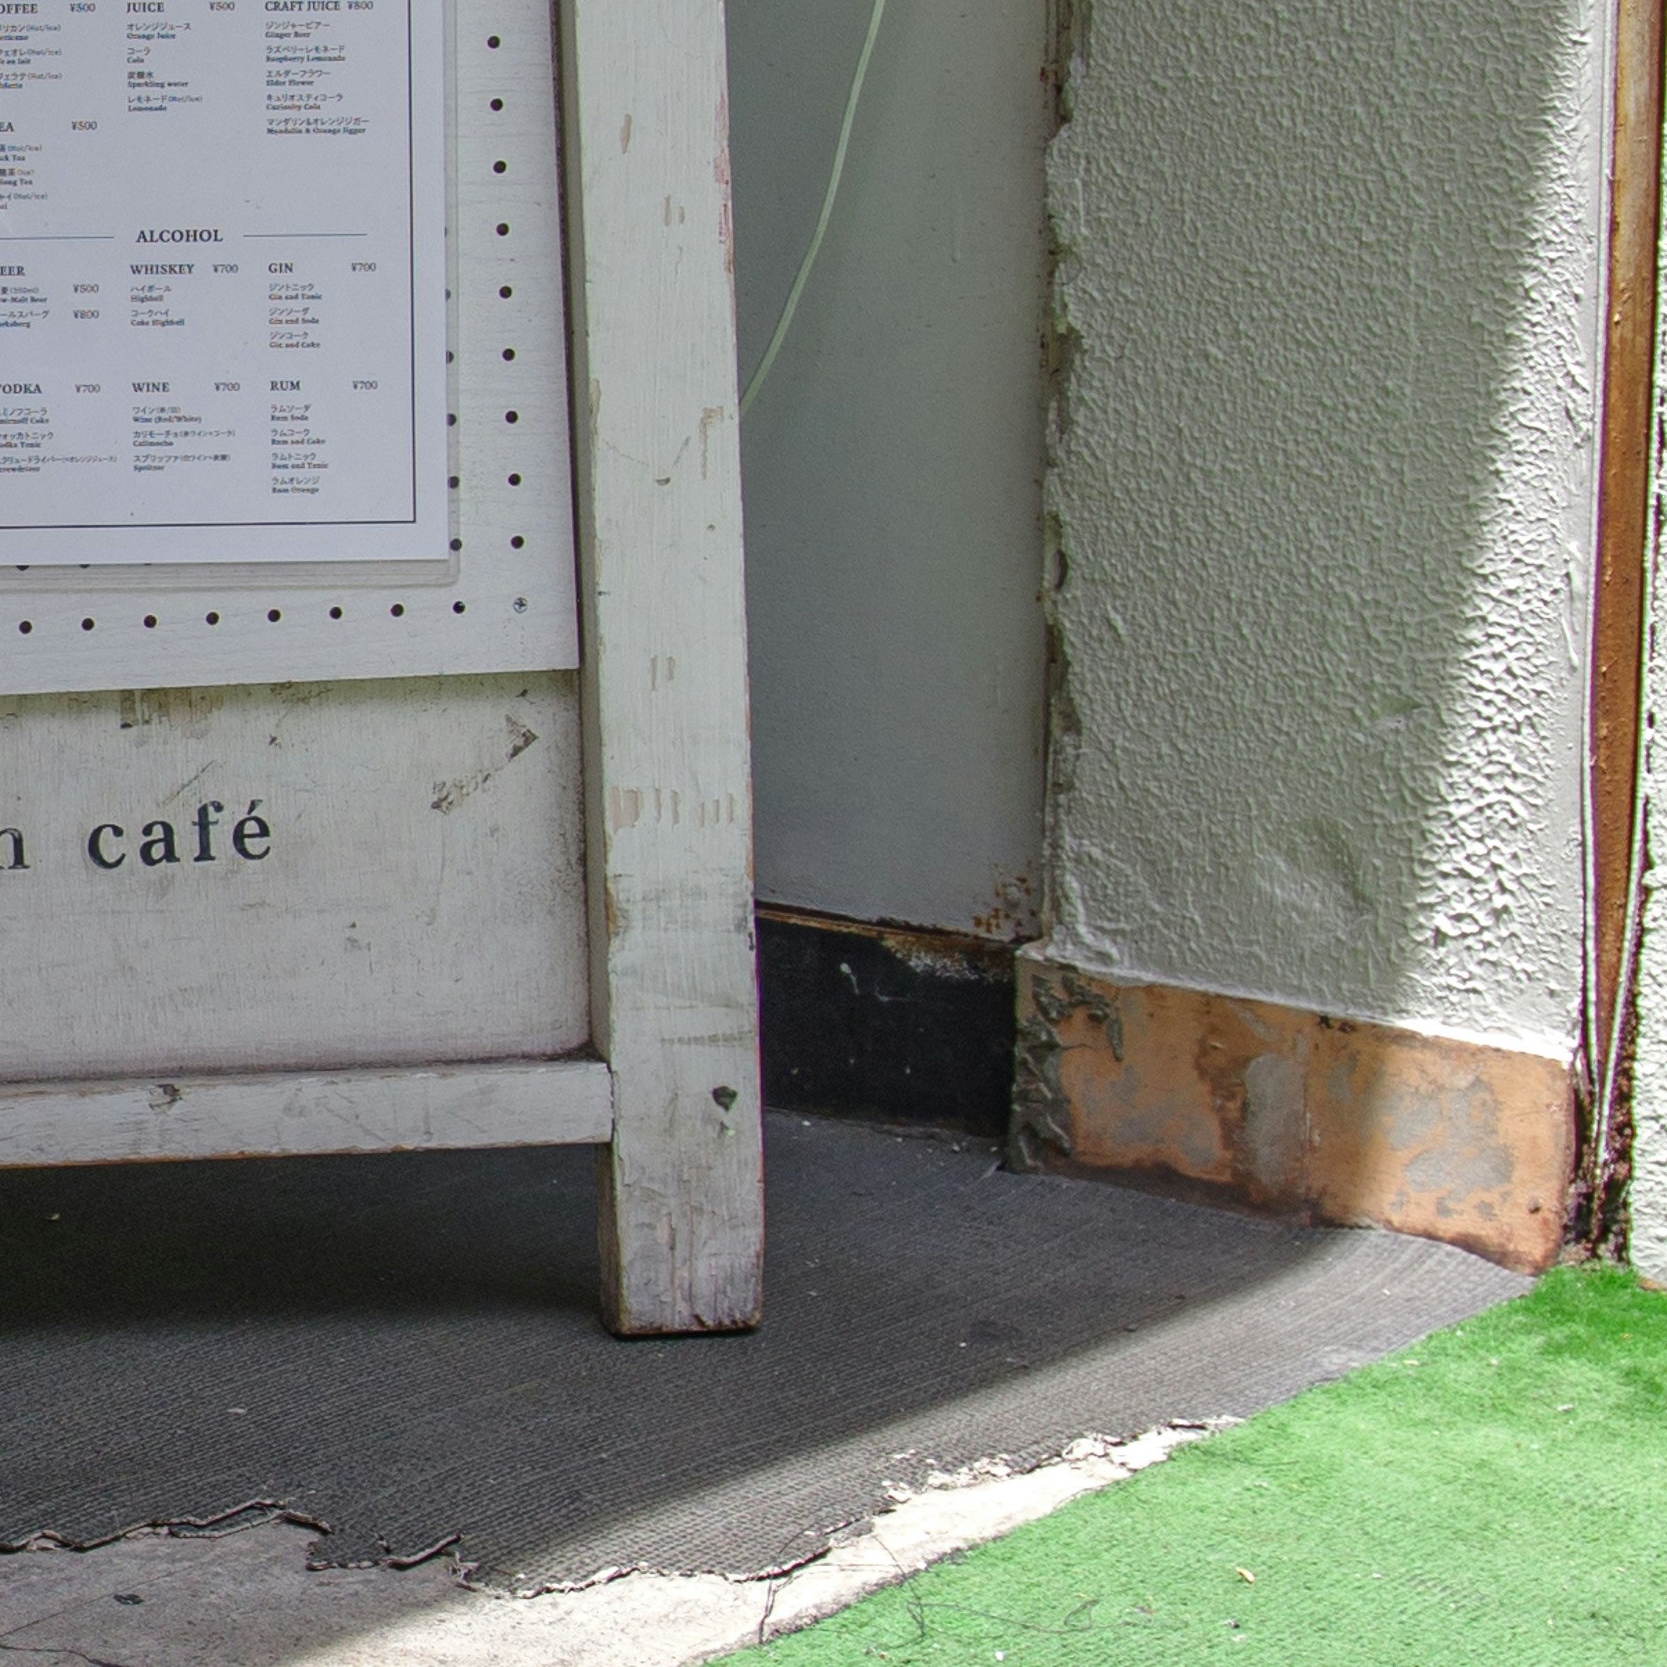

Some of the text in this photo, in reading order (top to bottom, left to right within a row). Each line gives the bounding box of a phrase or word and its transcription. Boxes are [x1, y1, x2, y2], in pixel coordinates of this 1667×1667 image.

[126, 1, 165, 13] JUICE
[265, 0, 304, 11] CRAFT
[306, 1, 340, 11] JUICE
[136, 229, 223, 243] ALCOHOL
[130, 264, 239, 275] WHISKEY ¥700
[268, 262, 377, 273] GIN ¥700
[75, 384, 101, 393] ¥700
[132, 382, 240, 393] WINE ¥700
[270, 380, 378, 391] RUM ¥700
[87, 797, 274, 870] café
